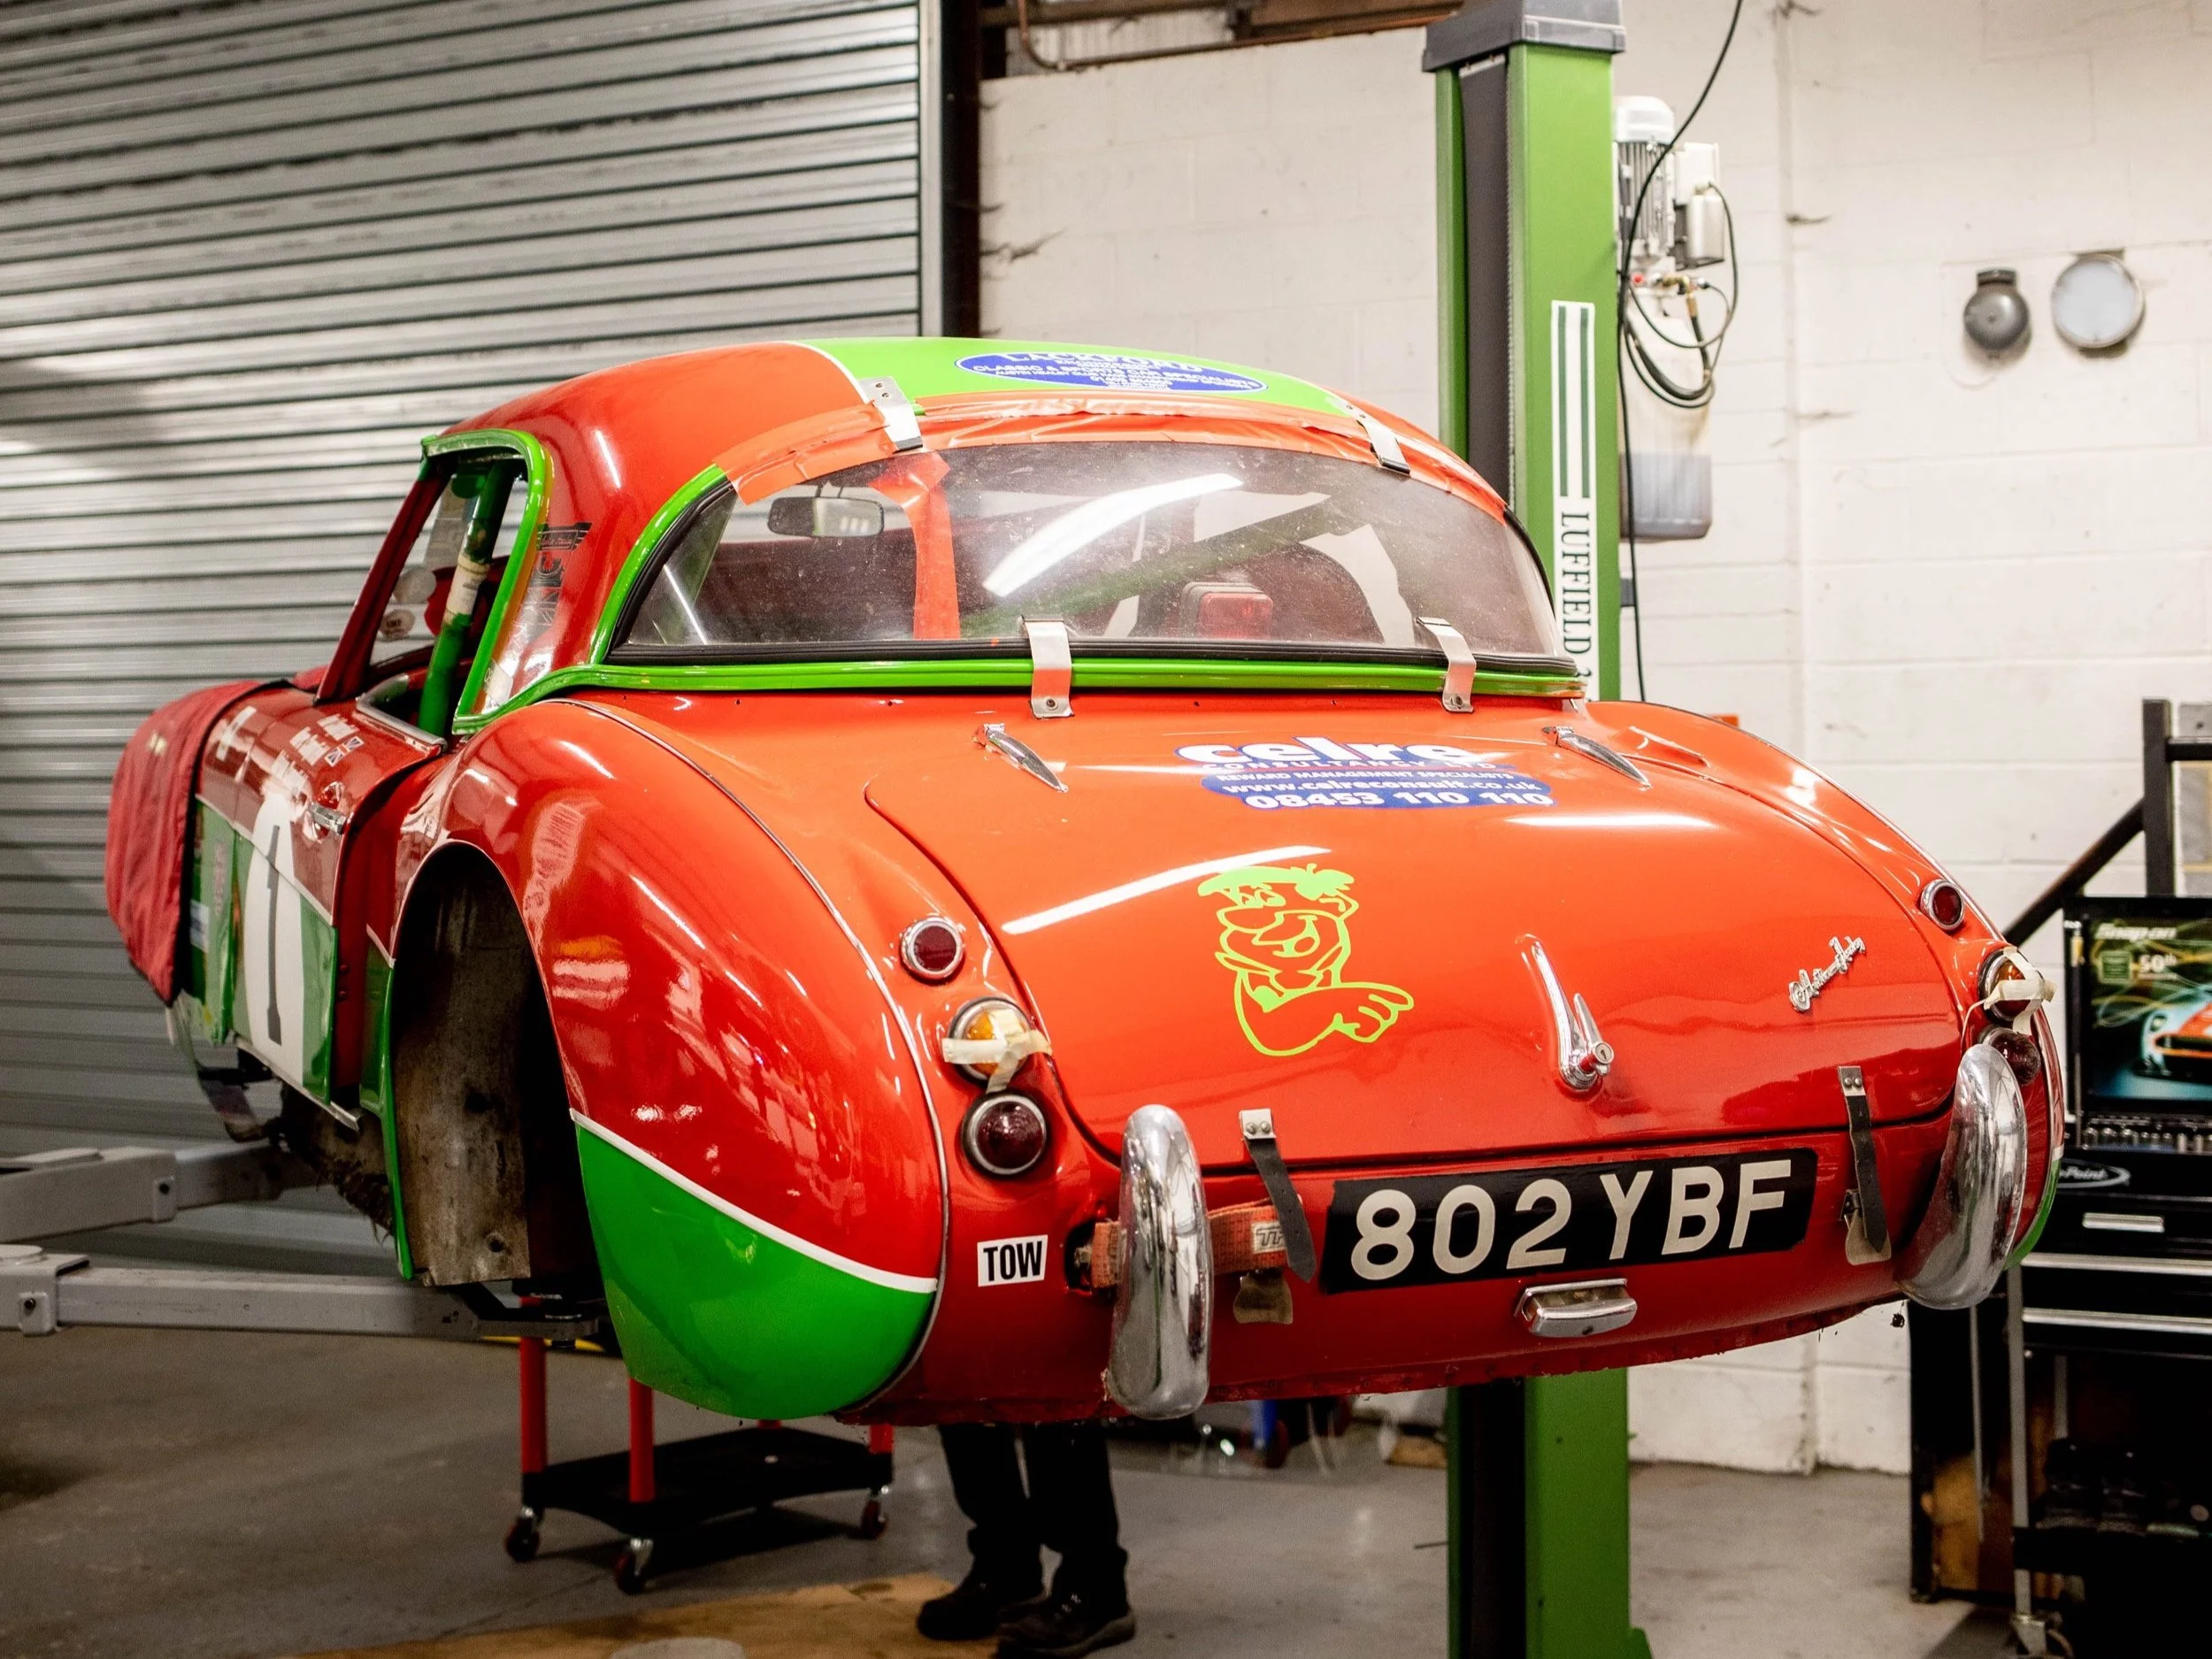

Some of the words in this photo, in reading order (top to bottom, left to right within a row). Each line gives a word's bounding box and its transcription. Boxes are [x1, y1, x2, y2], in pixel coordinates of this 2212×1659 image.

[1561, 511, 1593, 655] LUFFIELD
[1179, 737, 1481, 763] celre
[1216, 772, 1291, 781] REWARD
[1222, 780, 1543, 794] www.celreconsult.co.uk
[1246, 792, 1385, 809] 08453
[1394, 792, 1469, 804] 110
[1479, 792, 1555, 804] 110
[1351, 1178, 1572, 1280] 802
[1599, 1159, 1791, 1260] YBF
[983, 1240, 1042, 1282] TOW
